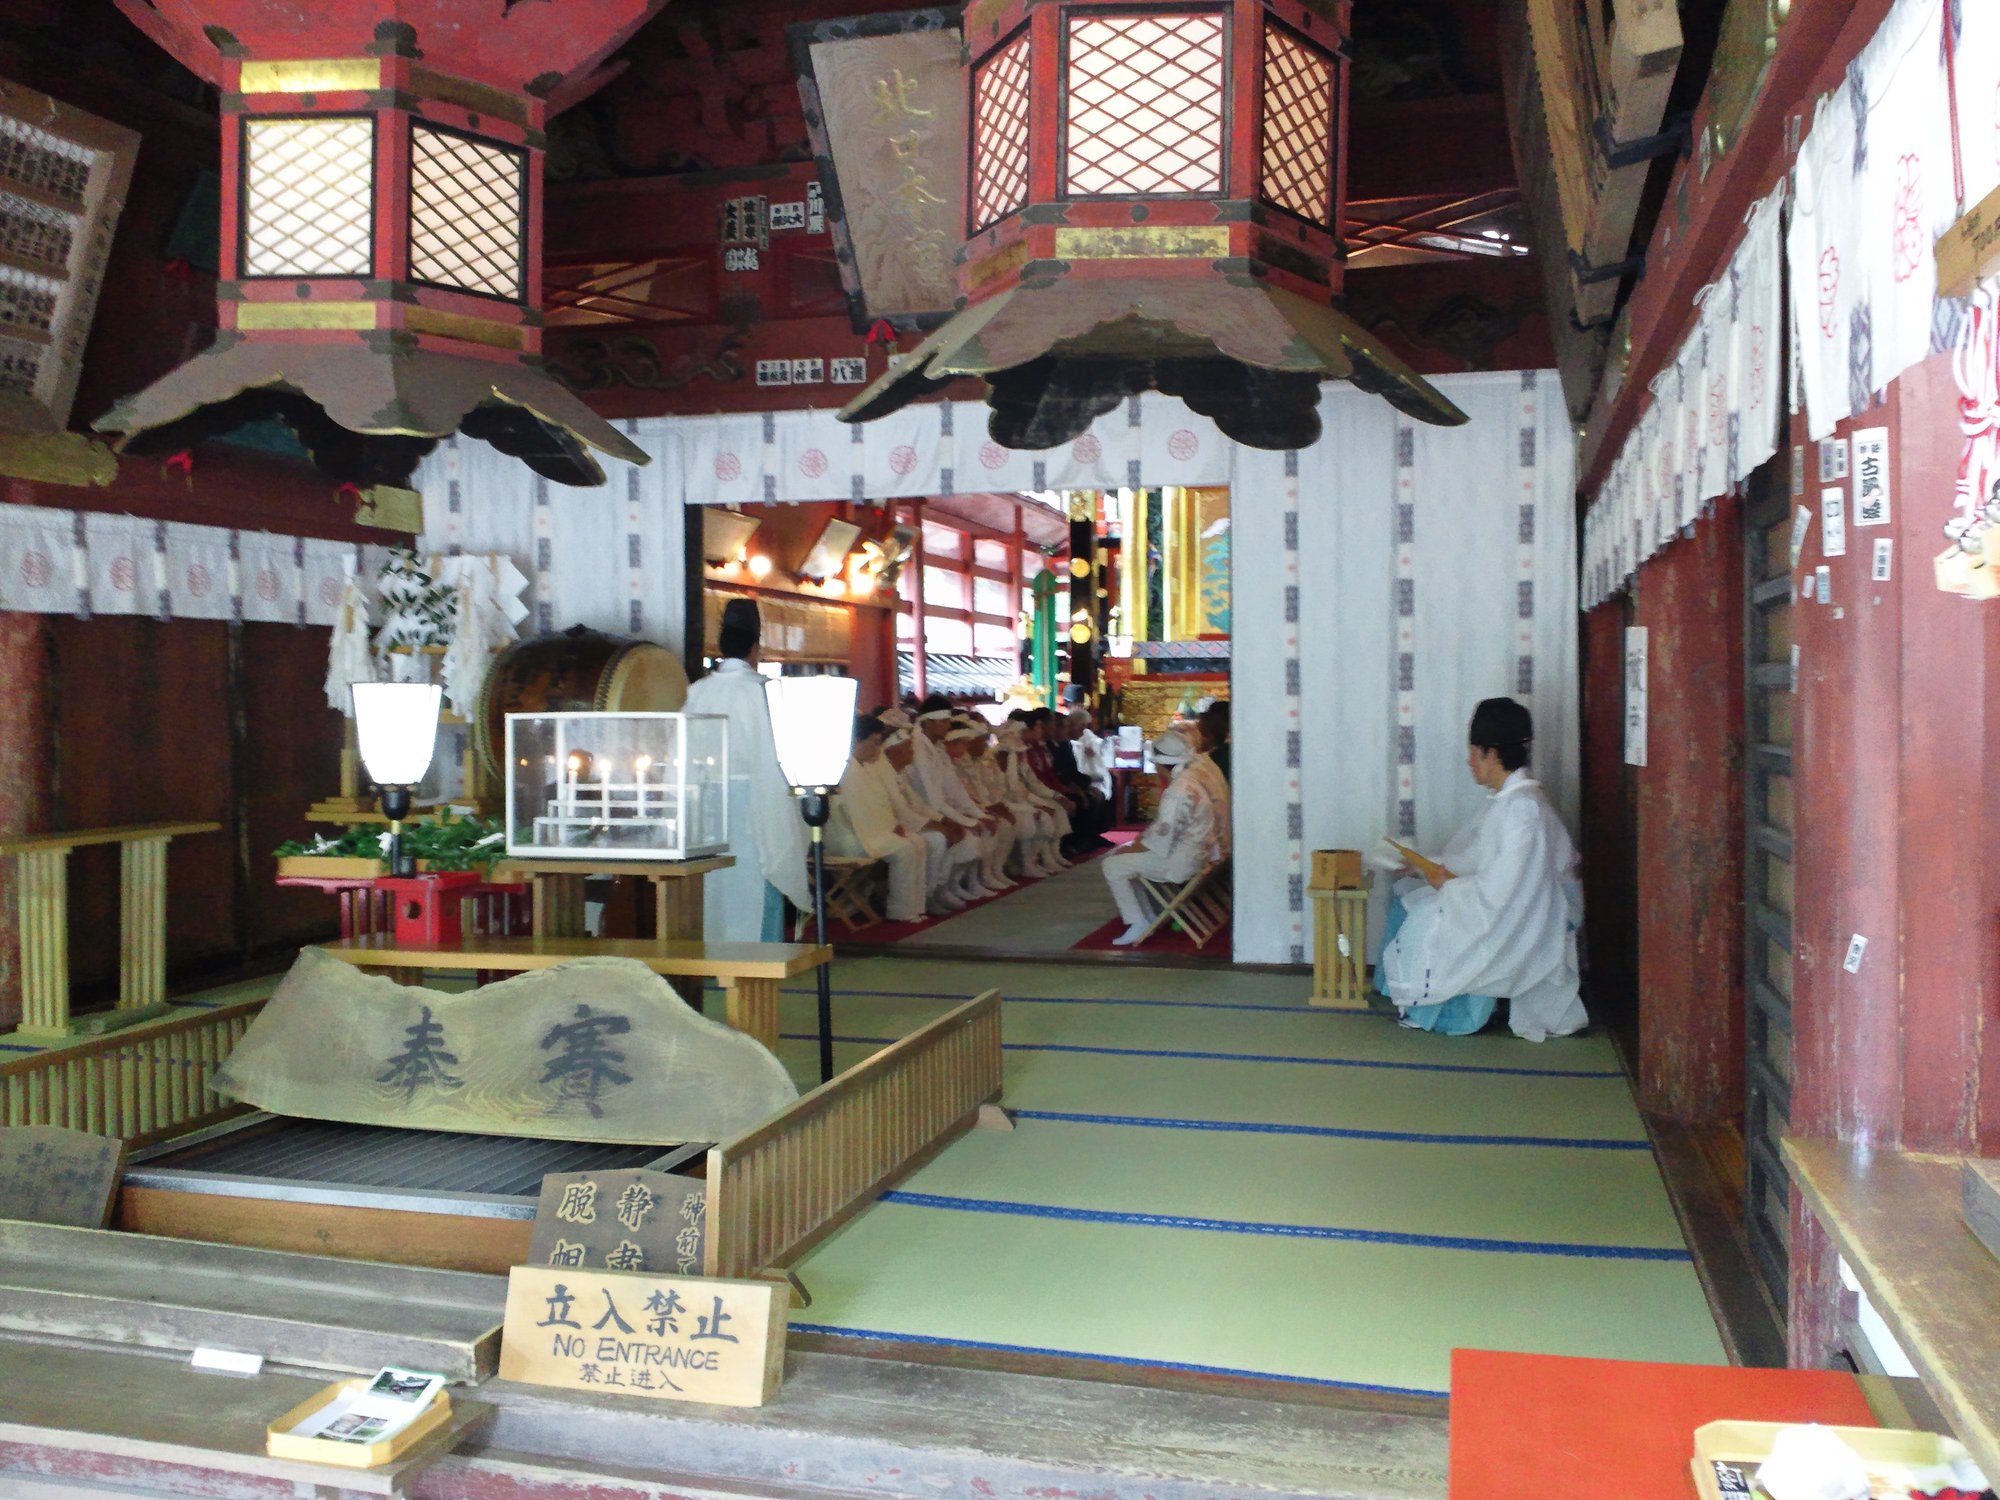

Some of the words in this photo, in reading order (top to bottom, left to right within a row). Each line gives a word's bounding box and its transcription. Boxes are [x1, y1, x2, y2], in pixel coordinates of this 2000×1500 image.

[537, 1284, 739, 1344] 立入禁止
[553, 1333, 585, 1358] NO
[597, 1337, 720, 1371] ENTRANCE
[579, 1363, 684, 1392] 禁止进入
